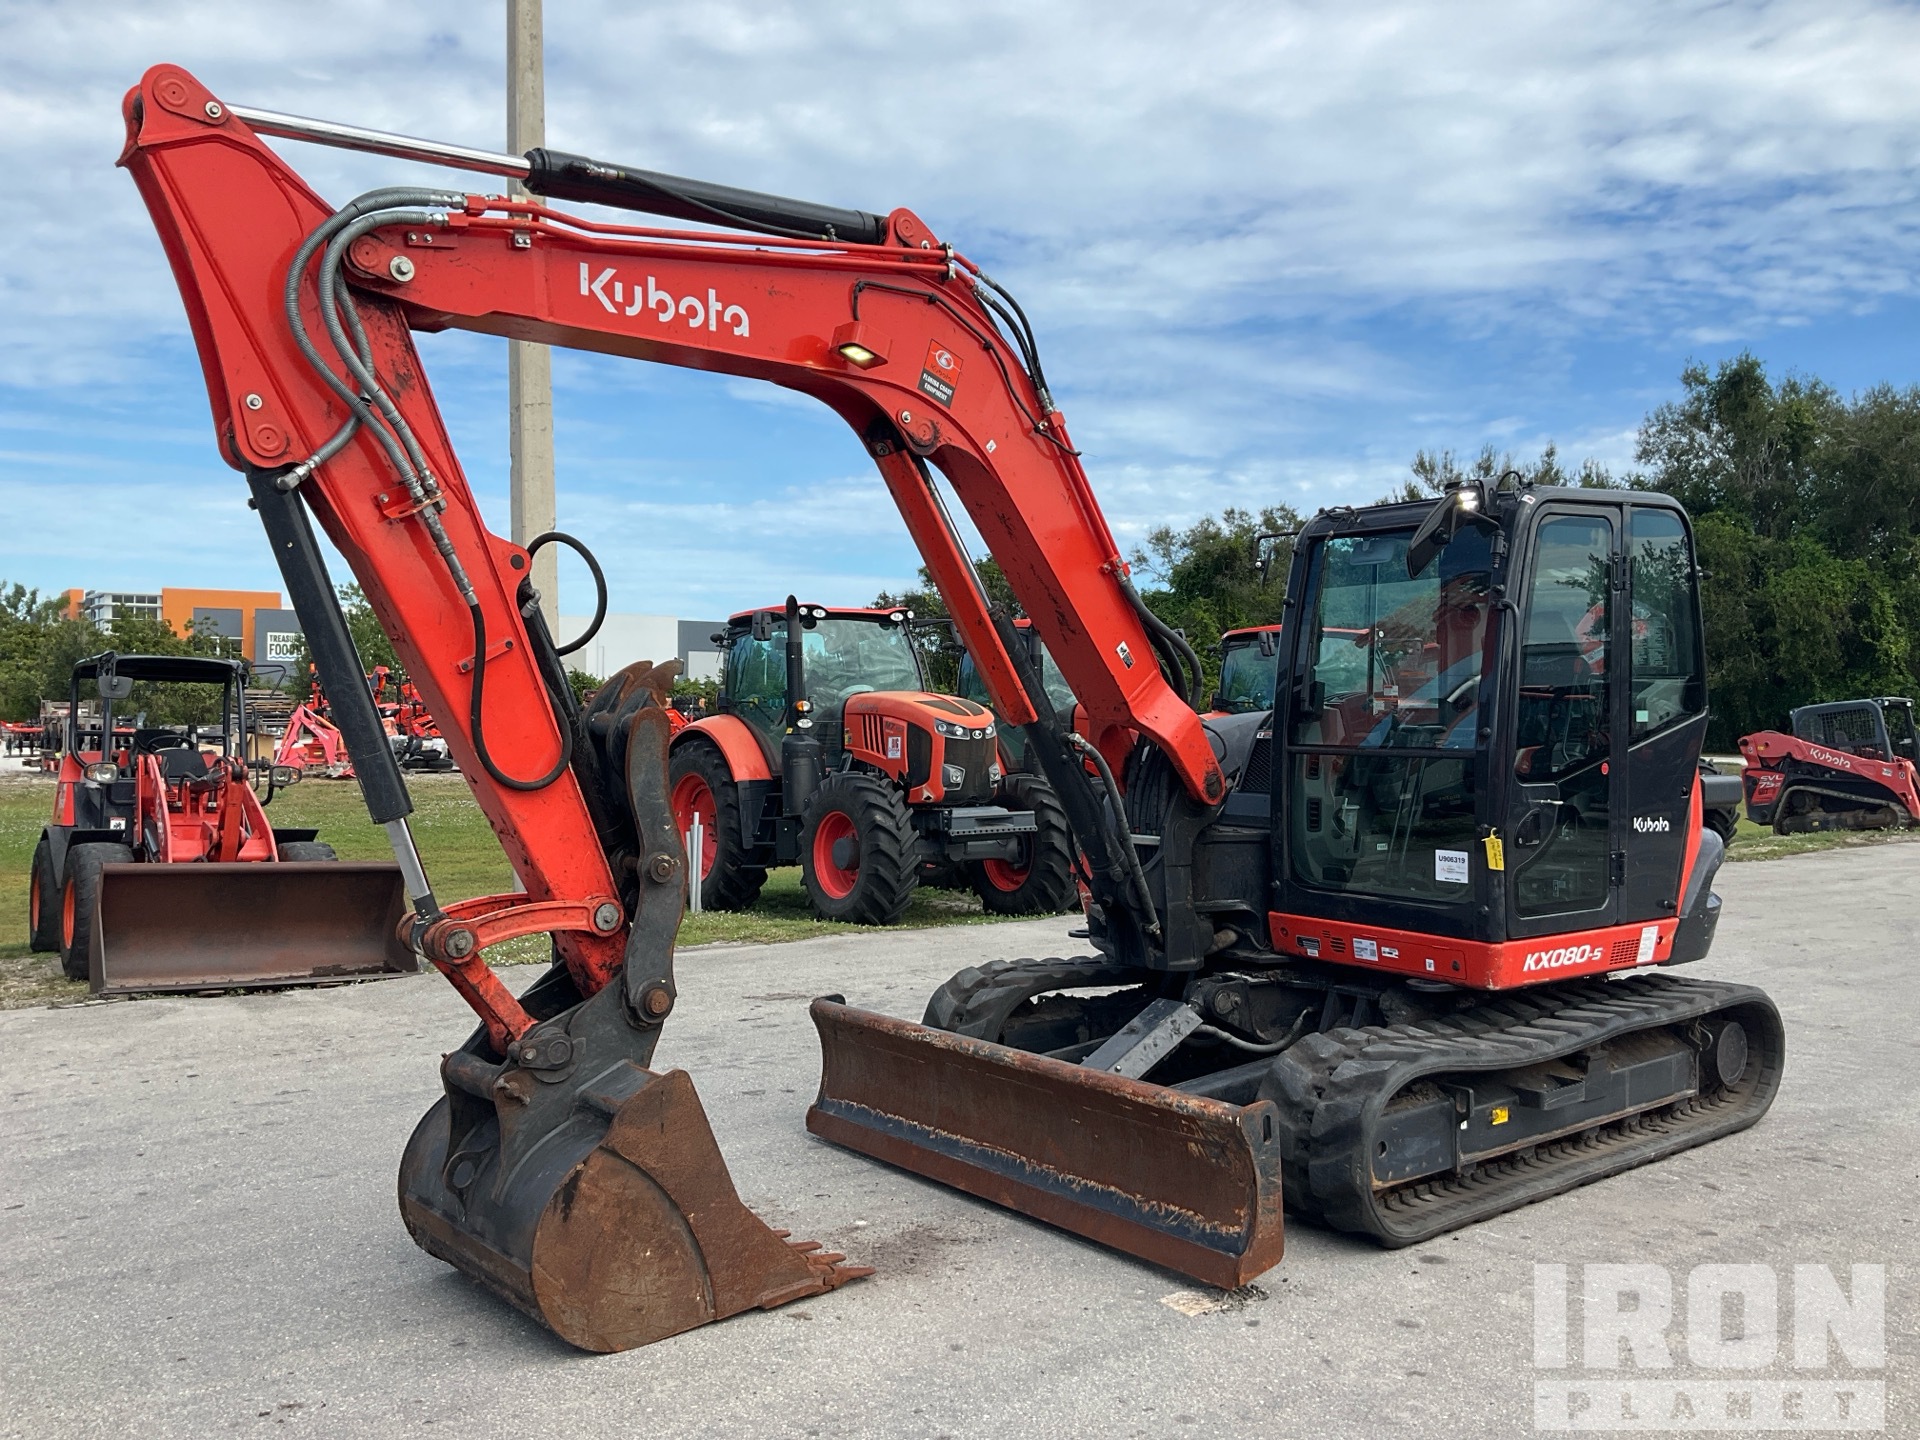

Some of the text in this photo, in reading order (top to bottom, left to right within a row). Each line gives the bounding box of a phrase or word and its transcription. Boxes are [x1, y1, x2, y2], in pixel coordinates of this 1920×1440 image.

[579, 262, 750, 338] Kubota
[1810, 747, 1851, 768] Kubota
[1760, 774, 1784, 782] SVL
[1633, 816, 1670, 832] Kubota
[1438, 854, 1466, 864] U906319
[1523, 944, 1604, 972] KX080-5
